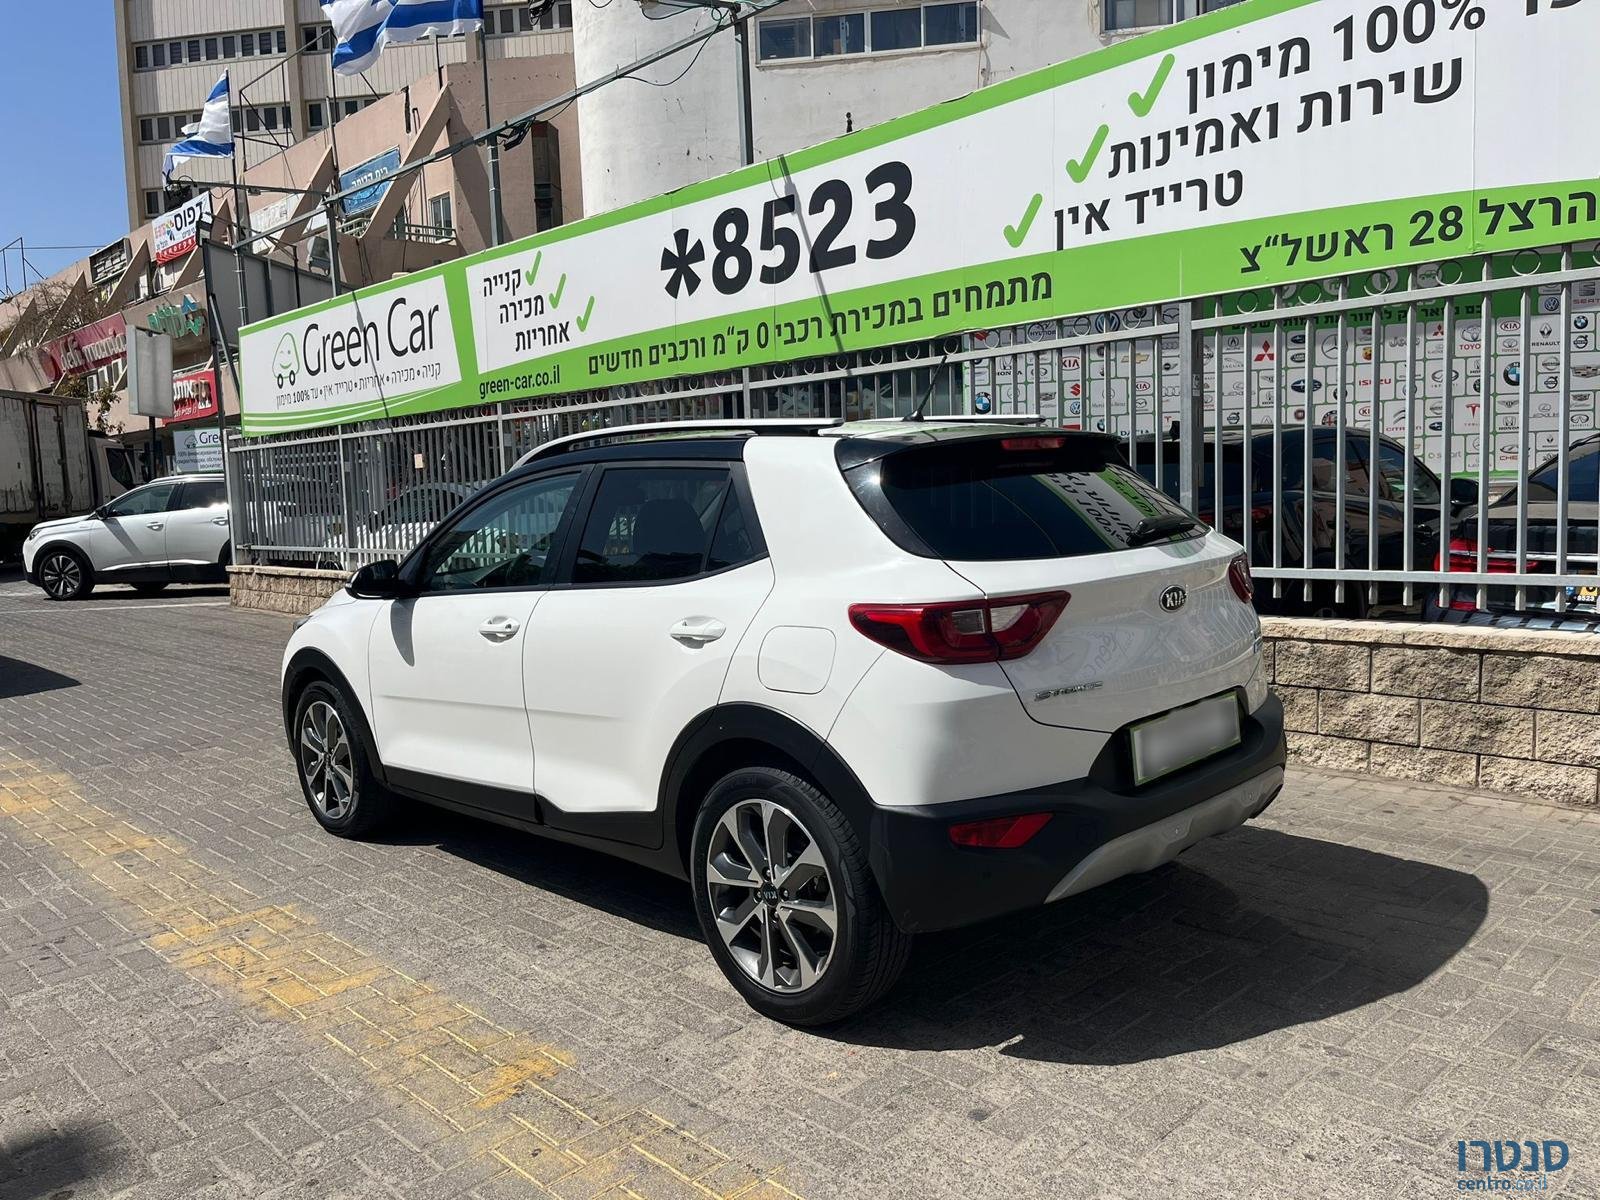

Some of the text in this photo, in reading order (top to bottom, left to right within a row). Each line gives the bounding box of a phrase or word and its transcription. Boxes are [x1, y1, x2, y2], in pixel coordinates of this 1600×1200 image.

[1187, 0, 1486, 115] 100% מימון
[1108, 57, 1462, 178] שירות ואמינות
[1054, 169, 1243, 251] טרייד אין
[1479, 191, 1597, 235] הרצל
[1409, 205, 1463, 247] 28
[484, 268, 521, 297] קנייה
[933, 272, 1052, 318] מתמחים
[500, 295, 544, 324] מכירה
[830, 297, 923, 336] במכירת
[303, 298, 439, 377] Green Car
[515, 321, 570, 352] אחריות
[756, 321, 769, 350] 0
[776, 316, 822, 345] רכבי
[1503, 322, 1519, 330] KIA
[589, 347, 643, 375] חדשים
[649, 336, 705, 366] ורכבים
[358, 374, 386, 391] אחריות
[391, 367, 416, 384] מכירה
[422, 362, 441, 381] קניה
[480, 365, 560, 399] green-car.co.il
[293, 389, 310, 403] 100%
[335, 381, 353, 393] טרייד
[1165, 590, 1187, 608] KIA
